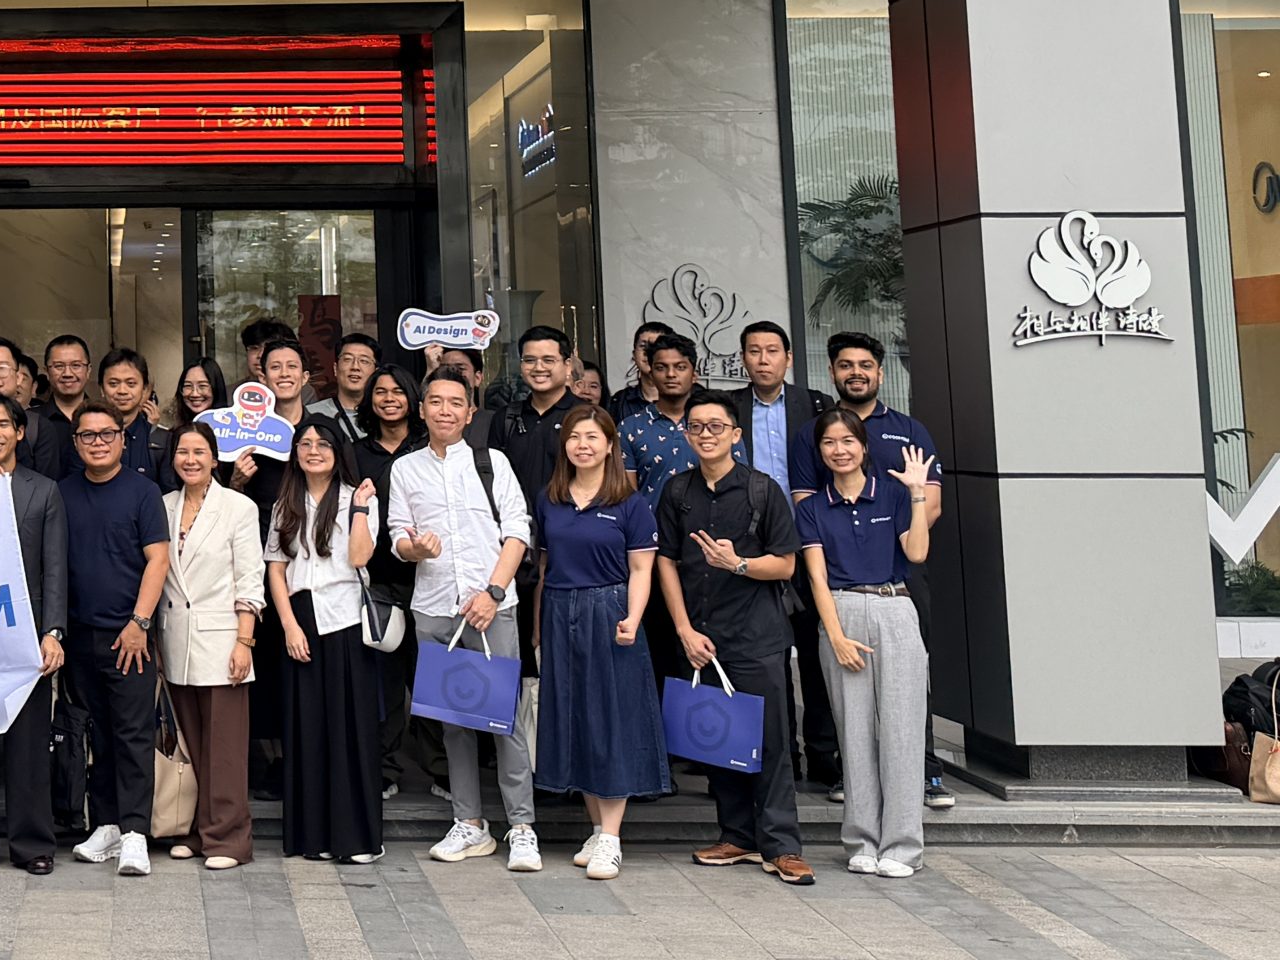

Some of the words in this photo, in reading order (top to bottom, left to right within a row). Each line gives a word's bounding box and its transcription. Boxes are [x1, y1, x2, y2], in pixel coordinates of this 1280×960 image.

[413, 325, 426, 335] AI
[428, 325, 468, 338] Design
[213, 427, 282, 443] All-in-One
